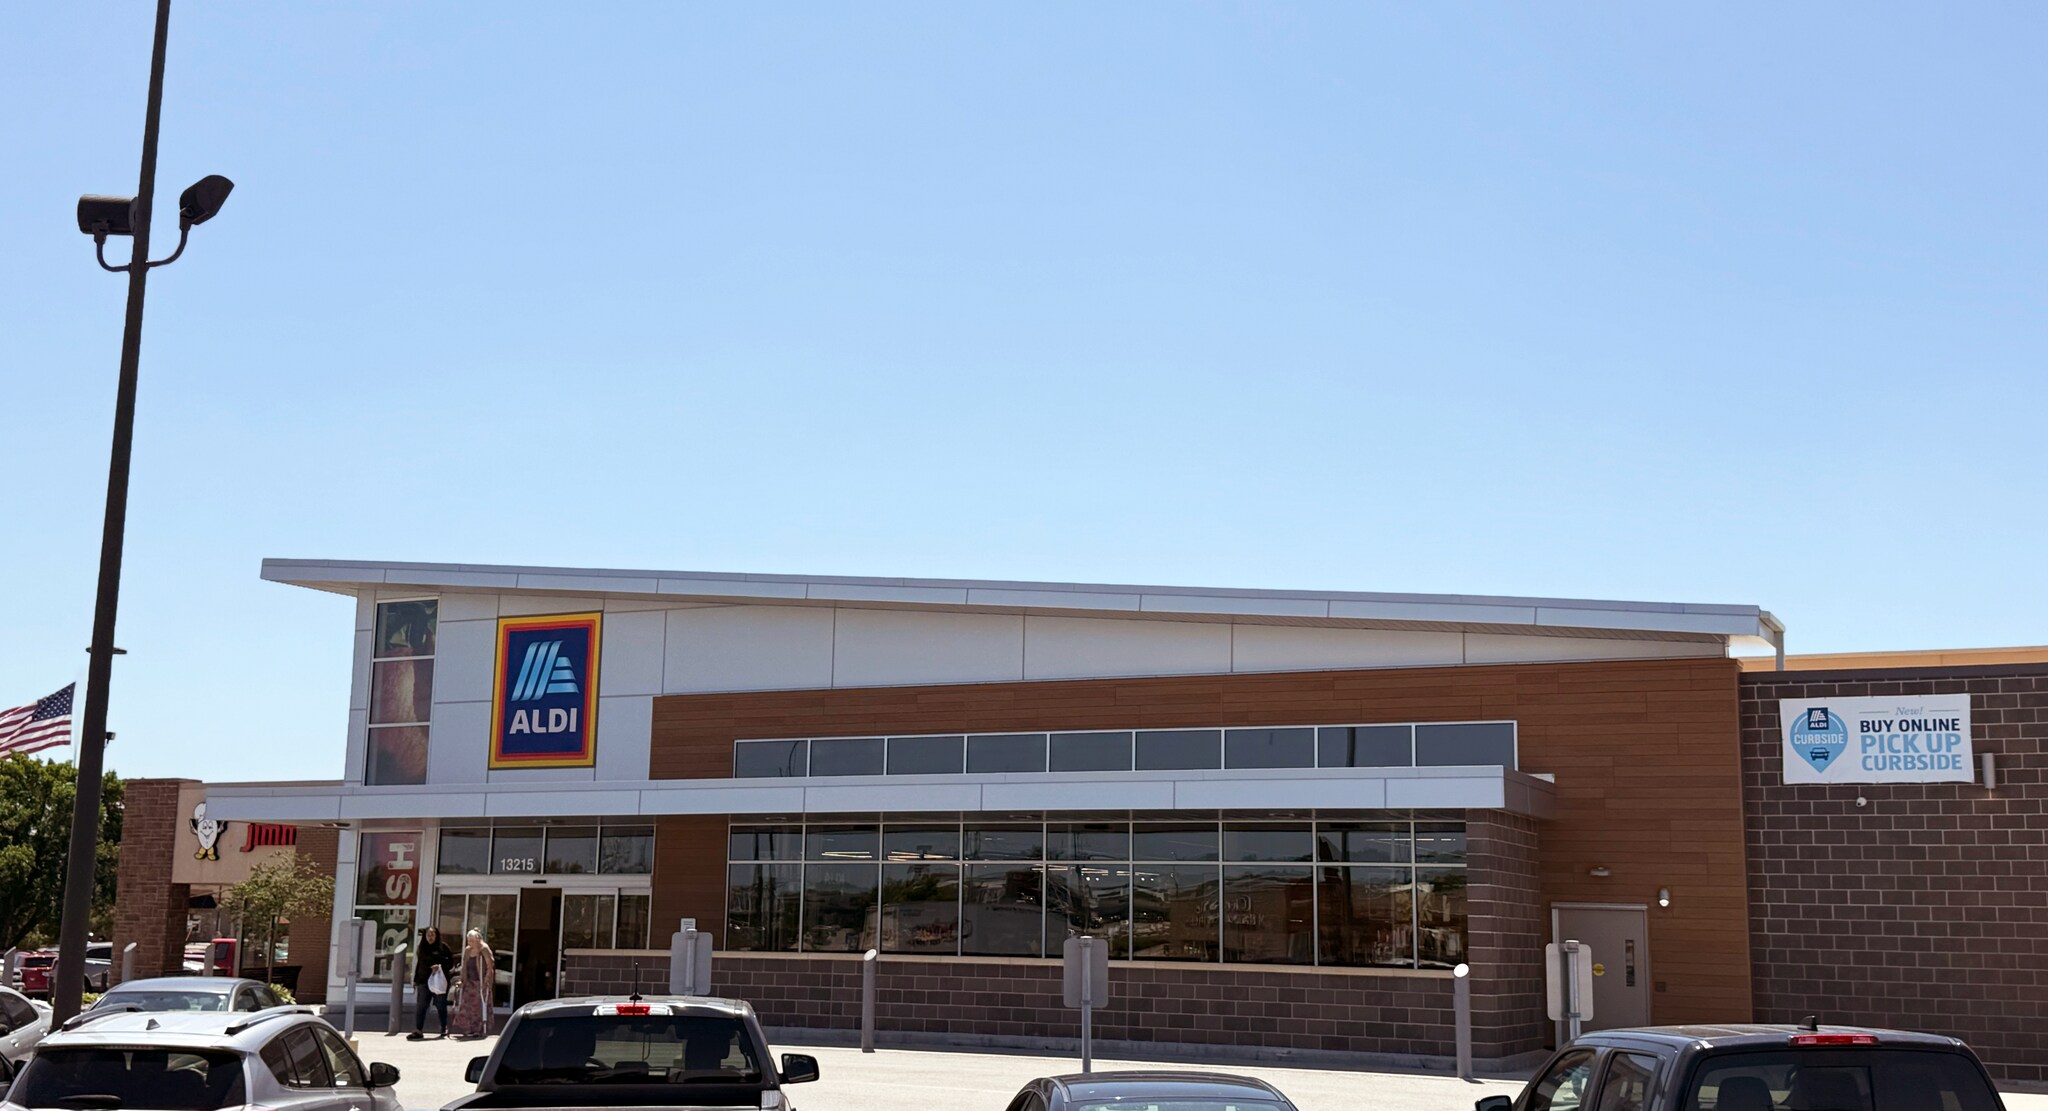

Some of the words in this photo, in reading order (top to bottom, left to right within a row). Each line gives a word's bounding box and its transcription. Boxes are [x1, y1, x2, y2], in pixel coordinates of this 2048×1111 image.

[1895, 707, 1923, 716] New!
[509, 707, 578, 735] ALDI
[1860, 719, 1894, 733] BUY
[1898, 718, 1961, 732] ONLINE
[1794, 733, 1844, 744] CURBSIDE
[1860, 733, 1921, 754] PICK
[1925, 733, 1962, 753] UP
[1861, 754, 1962, 771] CURBSIDE
[501, 858, 535, 871] 13215
